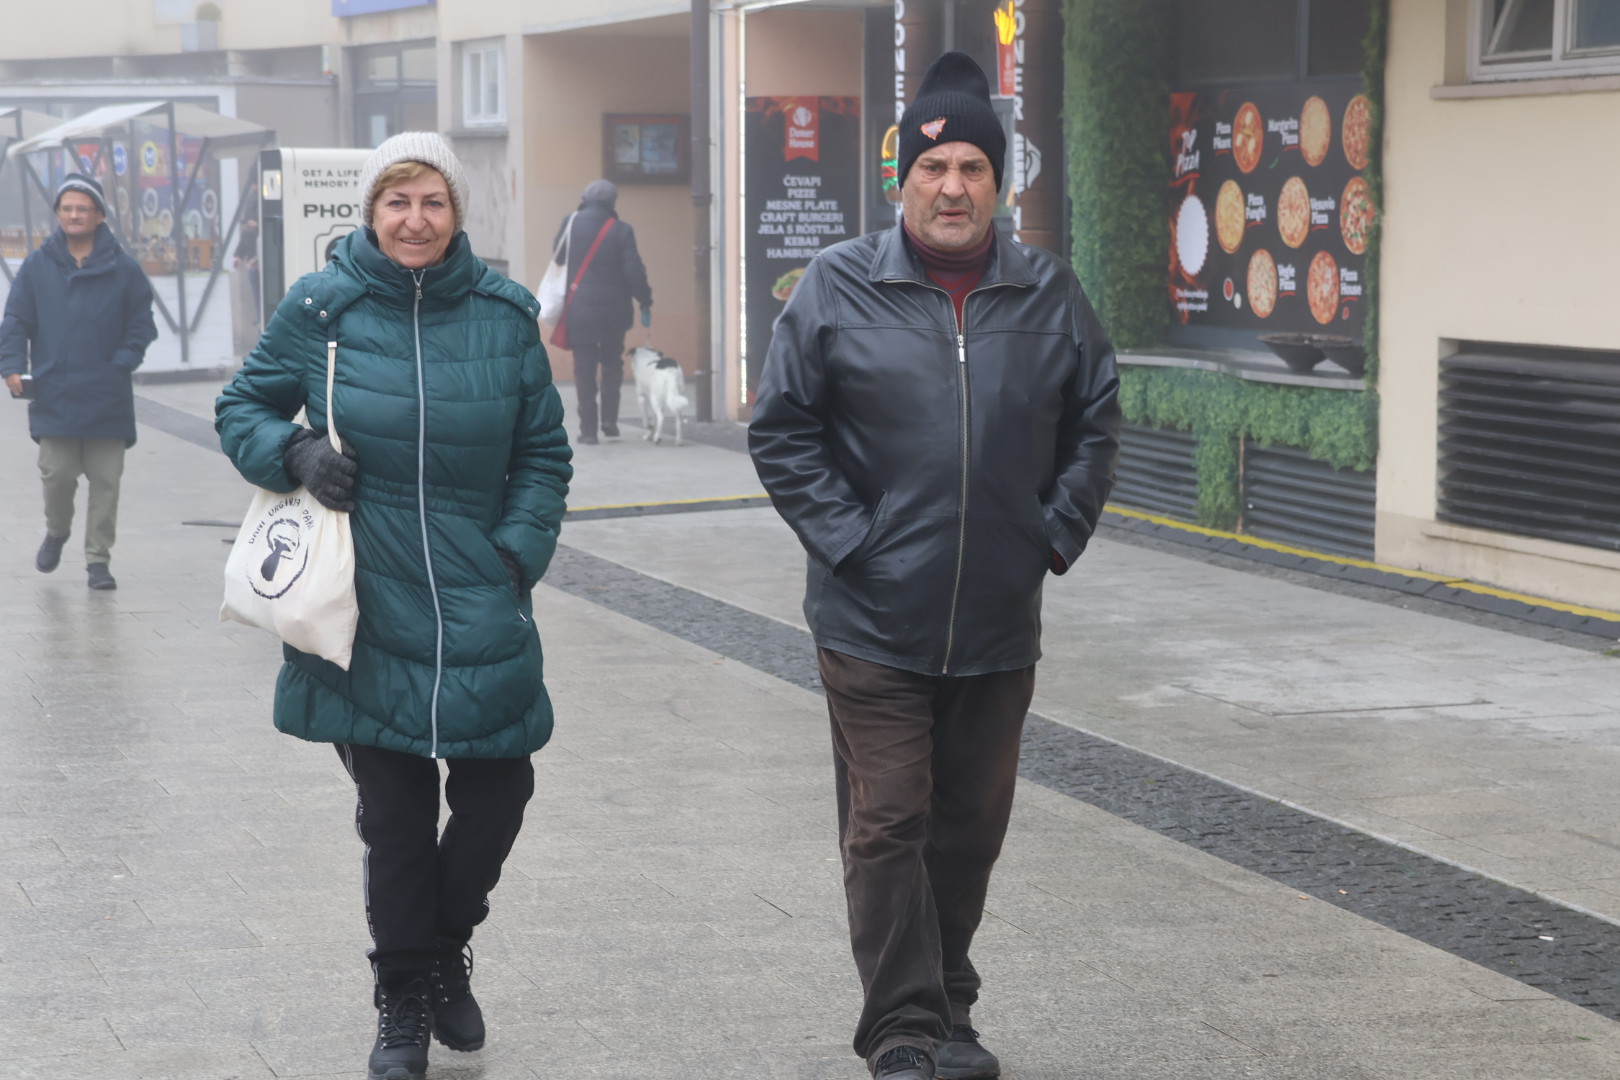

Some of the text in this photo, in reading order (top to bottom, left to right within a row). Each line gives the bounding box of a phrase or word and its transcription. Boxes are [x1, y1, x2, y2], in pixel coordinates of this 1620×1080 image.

[302, 169, 362, 178] GET A LIFE
[304, 180, 349, 188] MEMORY
[766, 200, 838, 211] MESNE PLATE
[760, 212, 844, 223] CRAFT BURGERI
[758, 224, 784, 235] JELA
[786, 224, 794, 235] S
[784, 236, 820, 247] KEBAB
